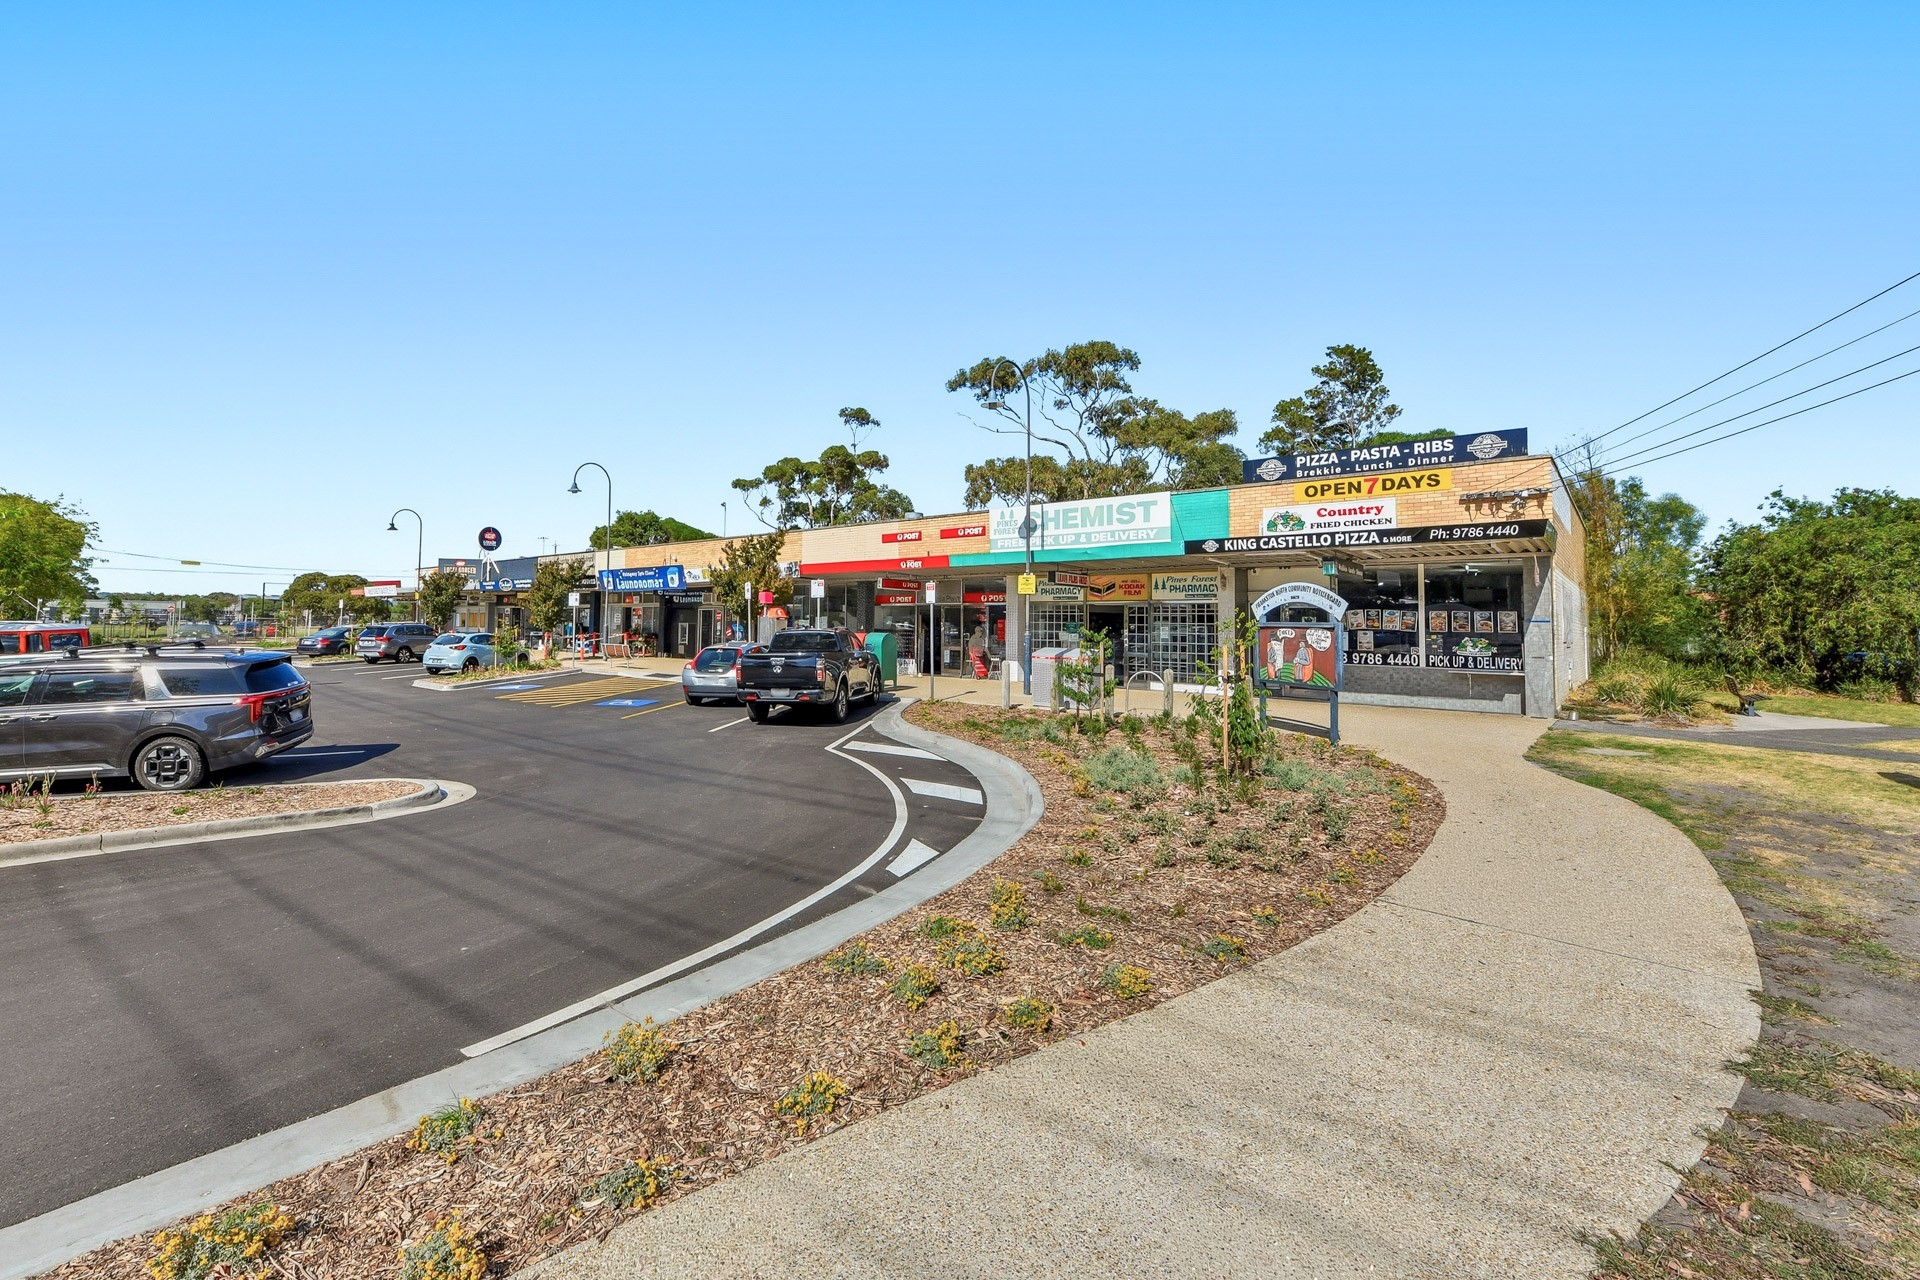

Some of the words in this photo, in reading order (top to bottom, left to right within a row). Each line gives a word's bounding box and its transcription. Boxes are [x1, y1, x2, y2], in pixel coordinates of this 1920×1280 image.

[1296, 452, 1339, 468] PIZZA
[1351, 445, 1401, 462] PASTA
[1414, 439, 1454, 455] RIBS
[1296, 466, 1341, 478] Brekkie
[1355, 460, 1393, 471] Lunch
[1408, 454, 1454, 466] Dinner
[1304, 480, 1362, 498] OPEN
[1363, 477, 1380, 495] 7
[1381, 473, 1440, 491] DAYS
[1316, 504, 1385, 518] Country
[1310, 521, 1341, 529] FRIED
[1343, 517, 1393, 528] CHICKEN
[903, 532, 920, 540] POST
[965, 527, 983, 535] POST
[1429, 528, 1449, 540] Ph:
[1452, 526, 1484, 538] 9786
[1486, 525, 1519, 537] 4440
[997, 538, 1025, 549] FREE
[1059, 535, 1074, 544] UP
[1079, 535, 1087, 543] &
[1091, 529, 1158, 542] DELIVERY
[1224, 537, 1257, 551] KING
[1259, 533, 1331, 549] CASTELLO
[1334, 531, 1380, 546] PIZZA
[1389, 535, 1412, 543] MORE
[1166, 576, 1188, 584] Pines
[1191, 575, 1217, 583] Forest
[1040, 587, 1082, 596] PHARMACY
[1288, 585, 1312, 593] COMMUNITY
[1352, 652, 1382, 665] 9786
[1387, 653, 1419, 666] 4440
[1429, 654, 1450, 667] PICK
[1453, 655, 1465, 668] UP
[1467, 656, 1475, 669] &
[1477, 657, 1523, 670] DELIVERY
